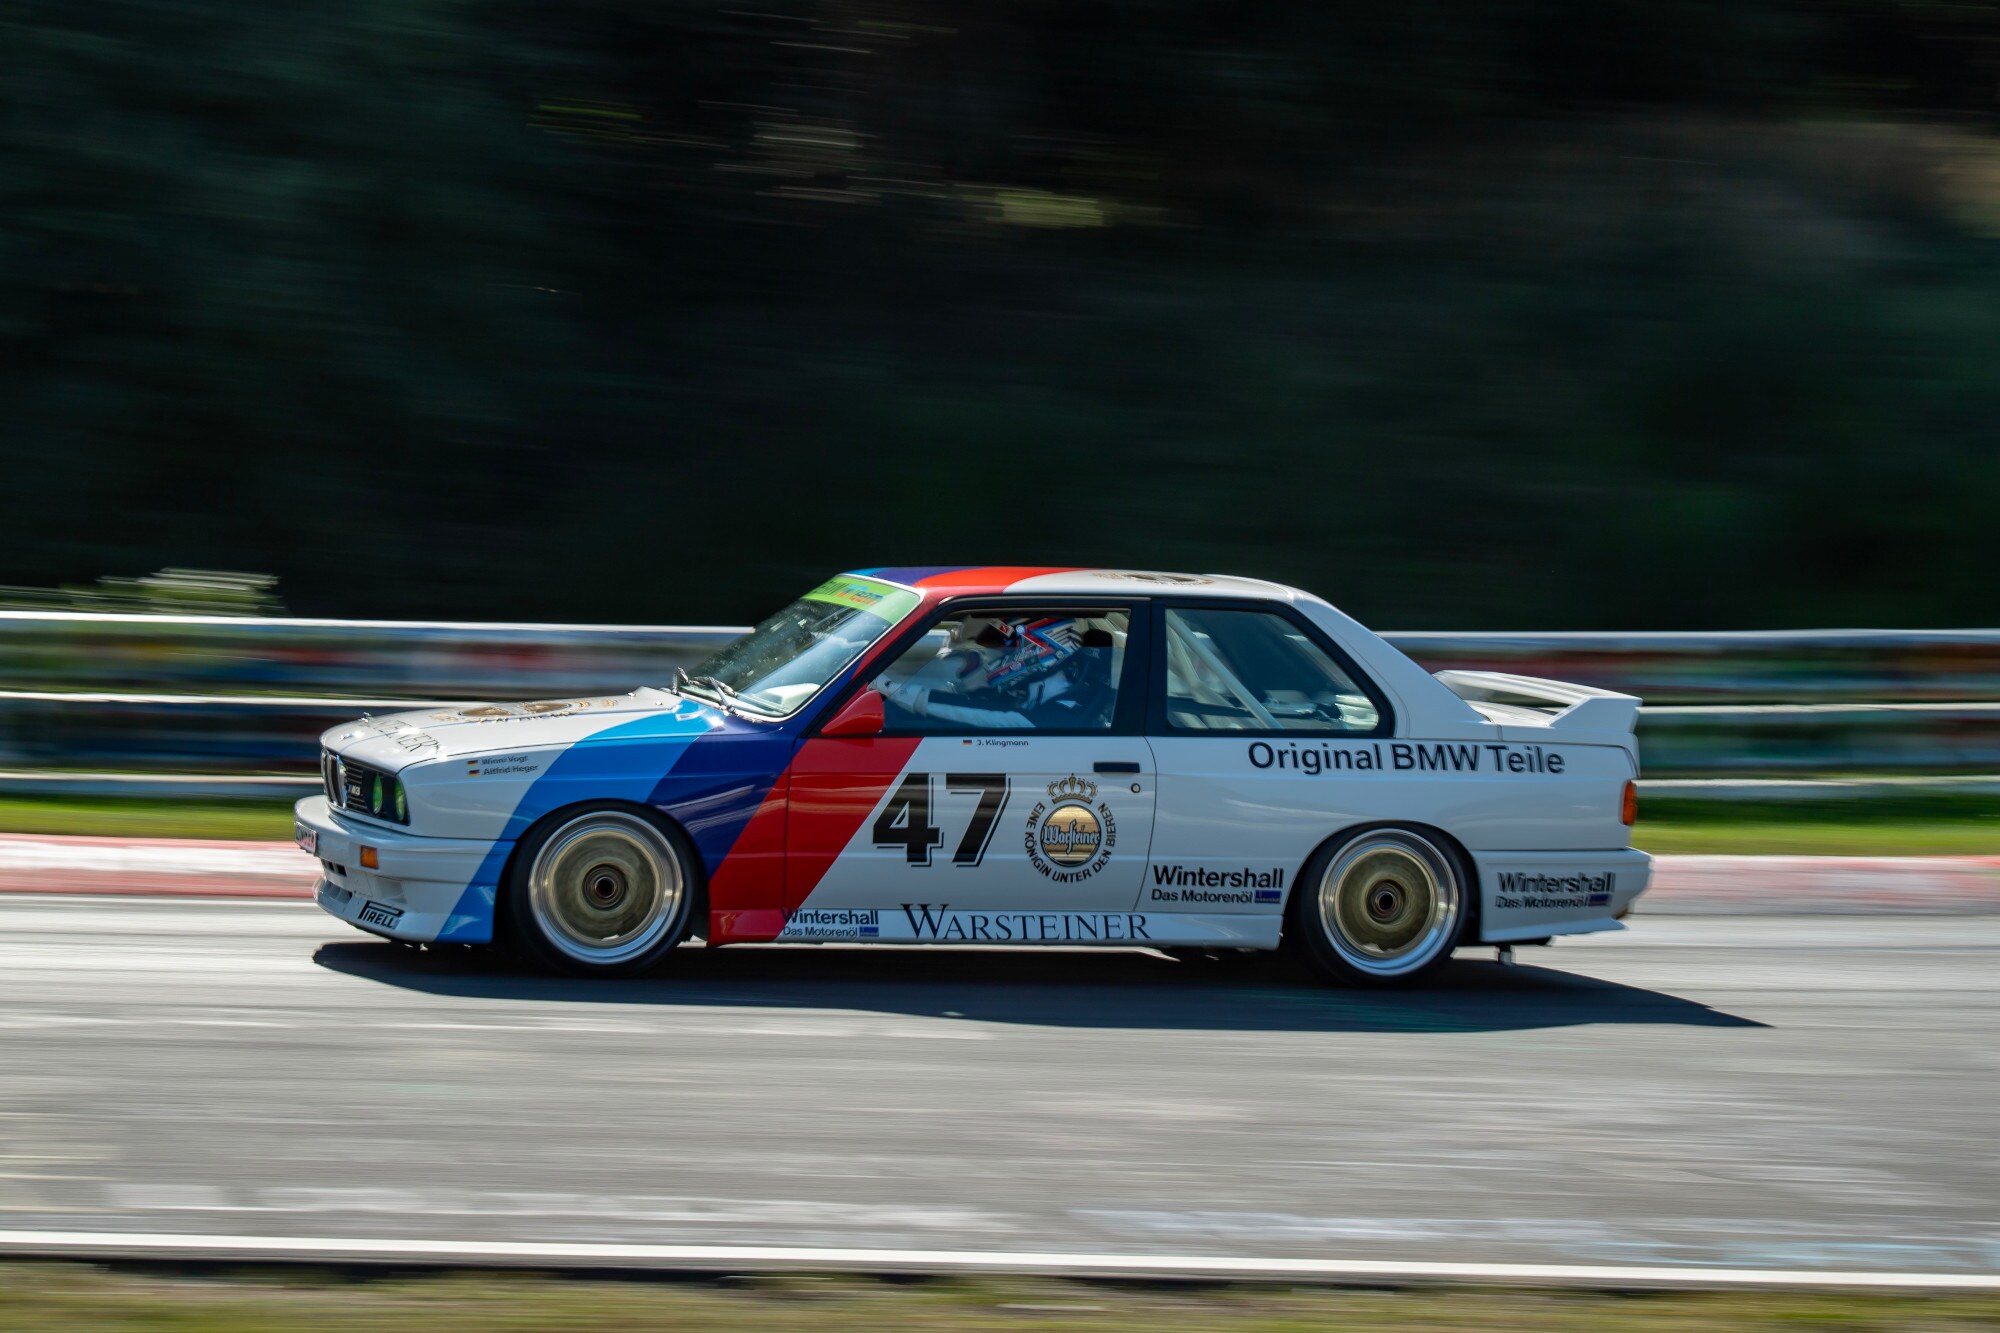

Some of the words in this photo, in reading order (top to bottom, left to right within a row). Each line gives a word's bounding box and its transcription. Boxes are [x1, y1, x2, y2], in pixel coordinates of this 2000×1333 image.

[985, 738, 1029, 747] Klingmann
[512, 765, 539, 774] Heger
[1248, 741, 1384, 775] Original
[1389, 742, 1481, 772] BMW
[1485, 744, 1567, 774] Teile
[873, 773, 1011, 867] 47
[1025, 801, 1046, 830] EINE
[1098, 802, 1117, 848] BIEREN
[1024, 832, 1053, 877] KÖNIGIN
[1092, 849, 1113, 874] DEN
[1051, 869, 1093, 883] UNTER
[1153, 865, 1284, 889] Wintershall
[1497, 871, 1616, 893] Wintershall
[1151, 888, 1179, 901] Das
[1181, 890, 1253, 904] Motorenöl
[1495, 895, 1522, 908] Das
[357, 900, 406, 930] PIRELLI
[781, 908, 879, 925] Wintershall
[901, 904, 1152, 940] WARSTEINER
[783, 926, 804, 936] Das
[805, 926, 858, 937] Motorenöl
